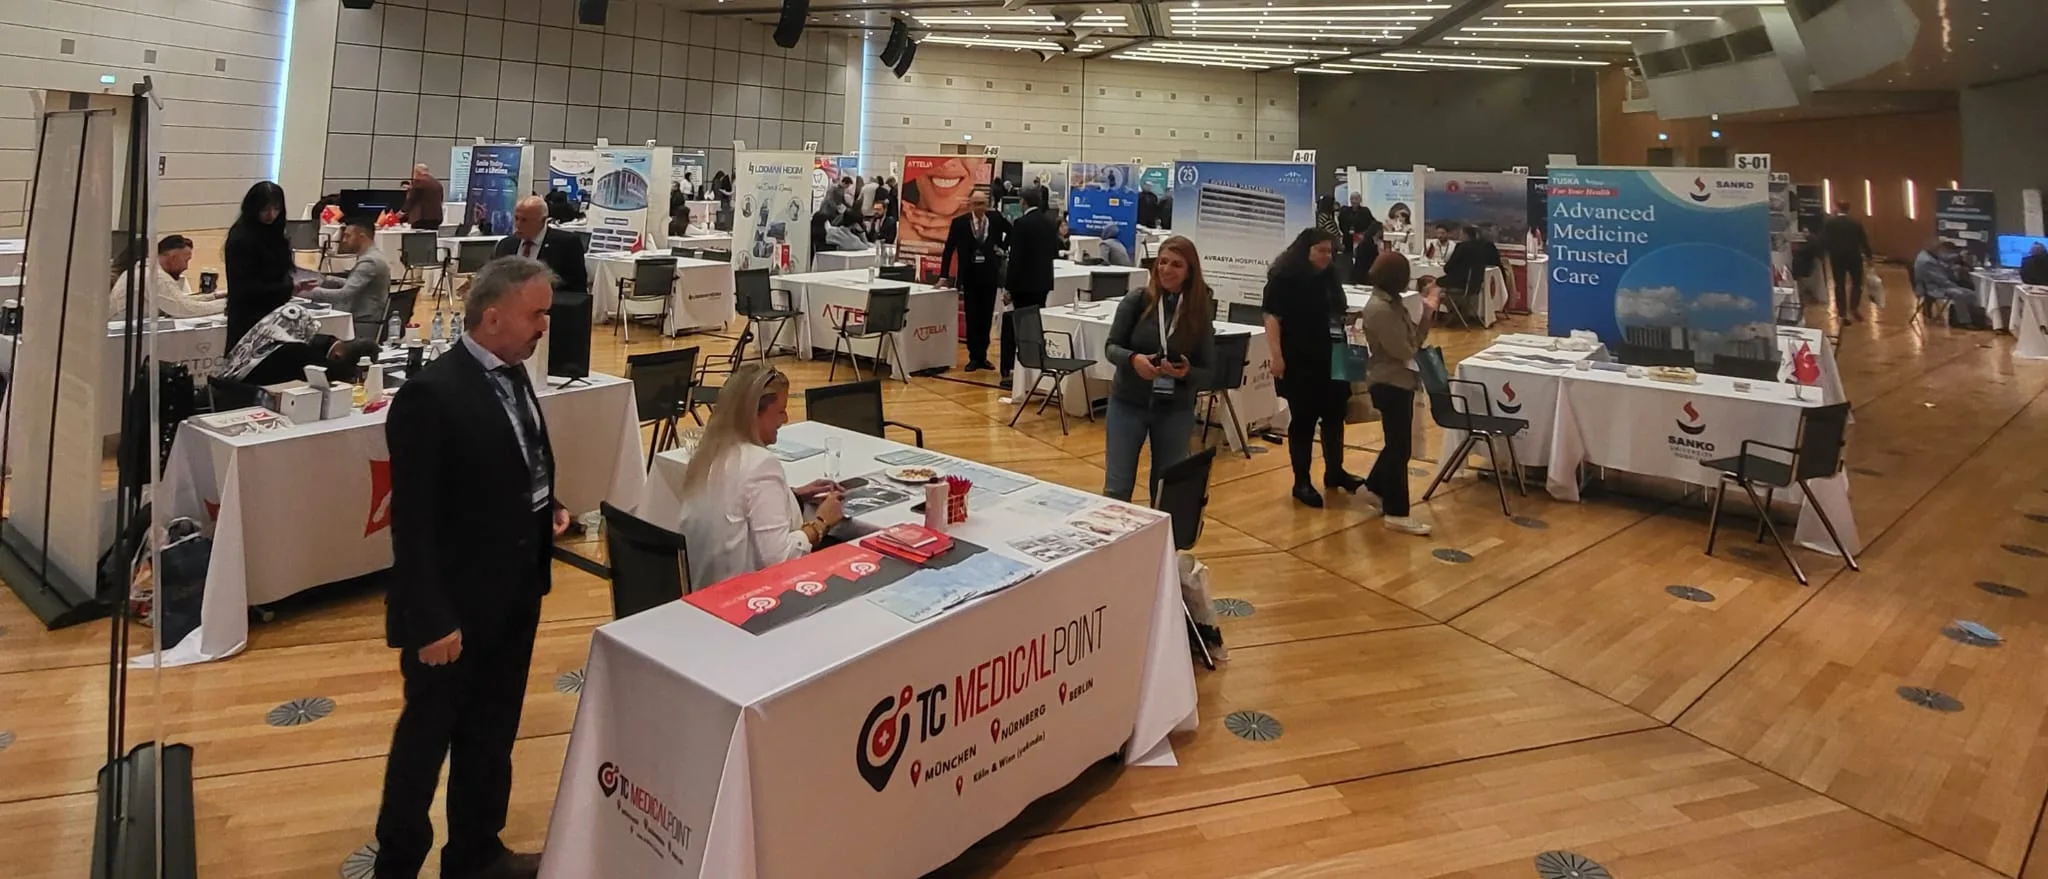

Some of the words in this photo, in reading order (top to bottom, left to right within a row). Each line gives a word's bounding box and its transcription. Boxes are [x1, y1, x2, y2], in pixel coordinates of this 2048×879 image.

[907, 160, 933, 168] ATTELIA
[1294, 152, 1314, 162] A-01
[1738, 156, 1768, 169] S-01
[1183, 168, 1193, 181] 25
[1552, 177, 1580, 185] TUSKA
[1715, 180, 1754, 189] SANKO
[1552, 201, 1656, 222] Advanced
[1553, 223, 1649, 244] Medicine
[1204, 255, 1233, 263] AVRASYA
[1552, 244, 1629, 265] Trusted
[1552, 266, 1600, 285] Care
[913, 323, 948, 341] ATTELIA
[1667, 435, 1716, 452] SANKO
[916, 683, 947, 744] TC
[954, 605, 1107, 727] MEDICALPOINT
[924, 743, 977, 782] MÜNCHEN
[1001, 704, 1047, 741] NÜRNBERG
[1069, 678, 1094, 702] BERLIN
[991, 762, 998, 773] &
[619, 774, 629, 800] TC
[630, 781, 693, 851] MEDICALPOINT
